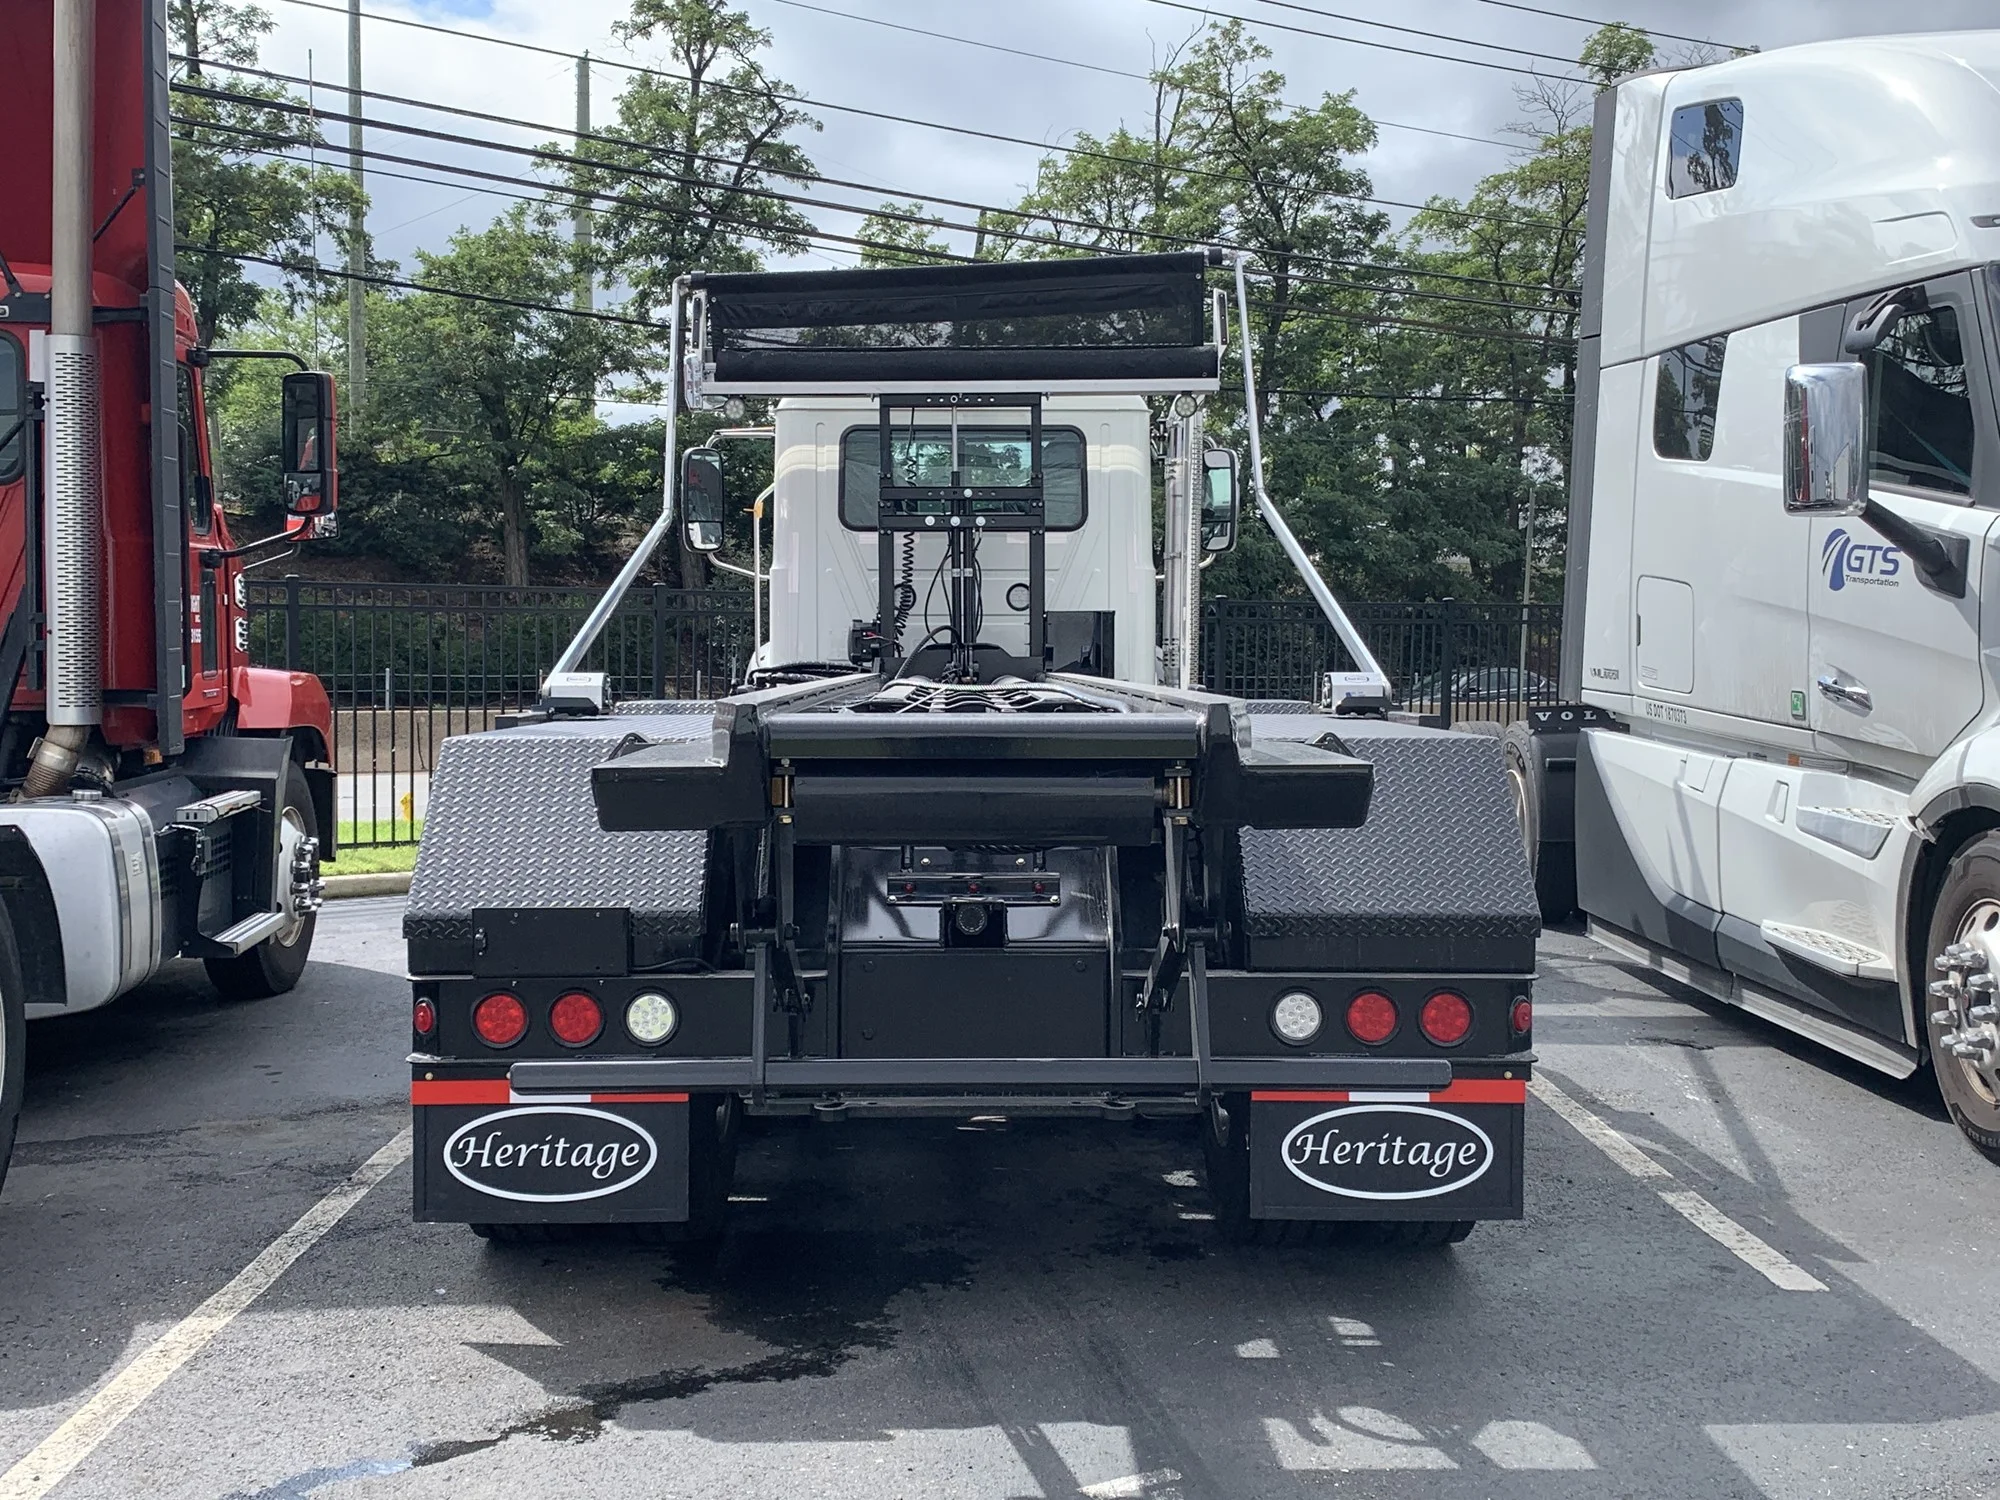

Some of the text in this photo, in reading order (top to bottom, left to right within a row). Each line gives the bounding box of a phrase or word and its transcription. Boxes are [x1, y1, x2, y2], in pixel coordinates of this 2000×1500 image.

[1846, 544, 1902, 576] GTS
[1845, 575, 1899, 587] Transportation
[1535, 710, 1617, 721] VOLV
[1645, 702, 1653, 716] US
[1653, 704, 1664, 719] DOT
[453, 1131, 640, 1179] Heritage
[1291, 1129, 1477, 1177] Heritage
